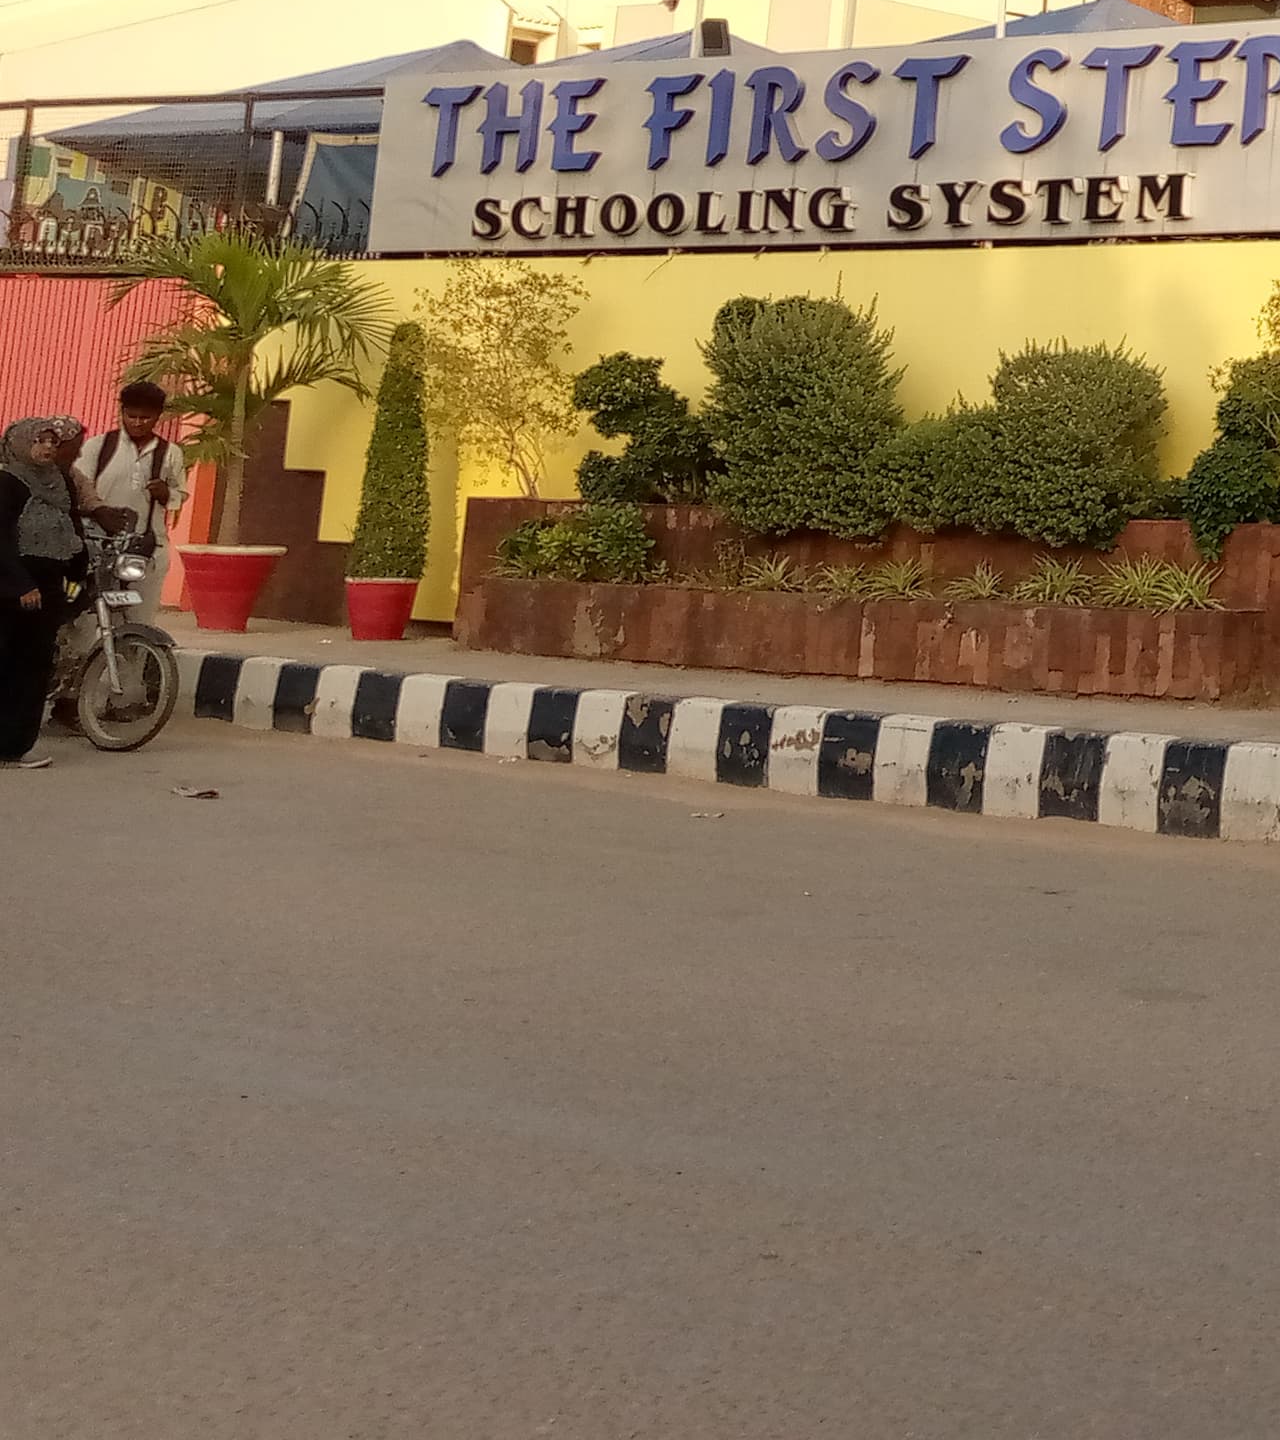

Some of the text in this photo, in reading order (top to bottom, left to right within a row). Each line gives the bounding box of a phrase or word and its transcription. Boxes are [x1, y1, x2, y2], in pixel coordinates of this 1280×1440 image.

[422, 77, 608, 178] THE
[642, 54, 973, 171] FIRST
[472, 172, 1196, 239] SCHOOLING SYSTEM
